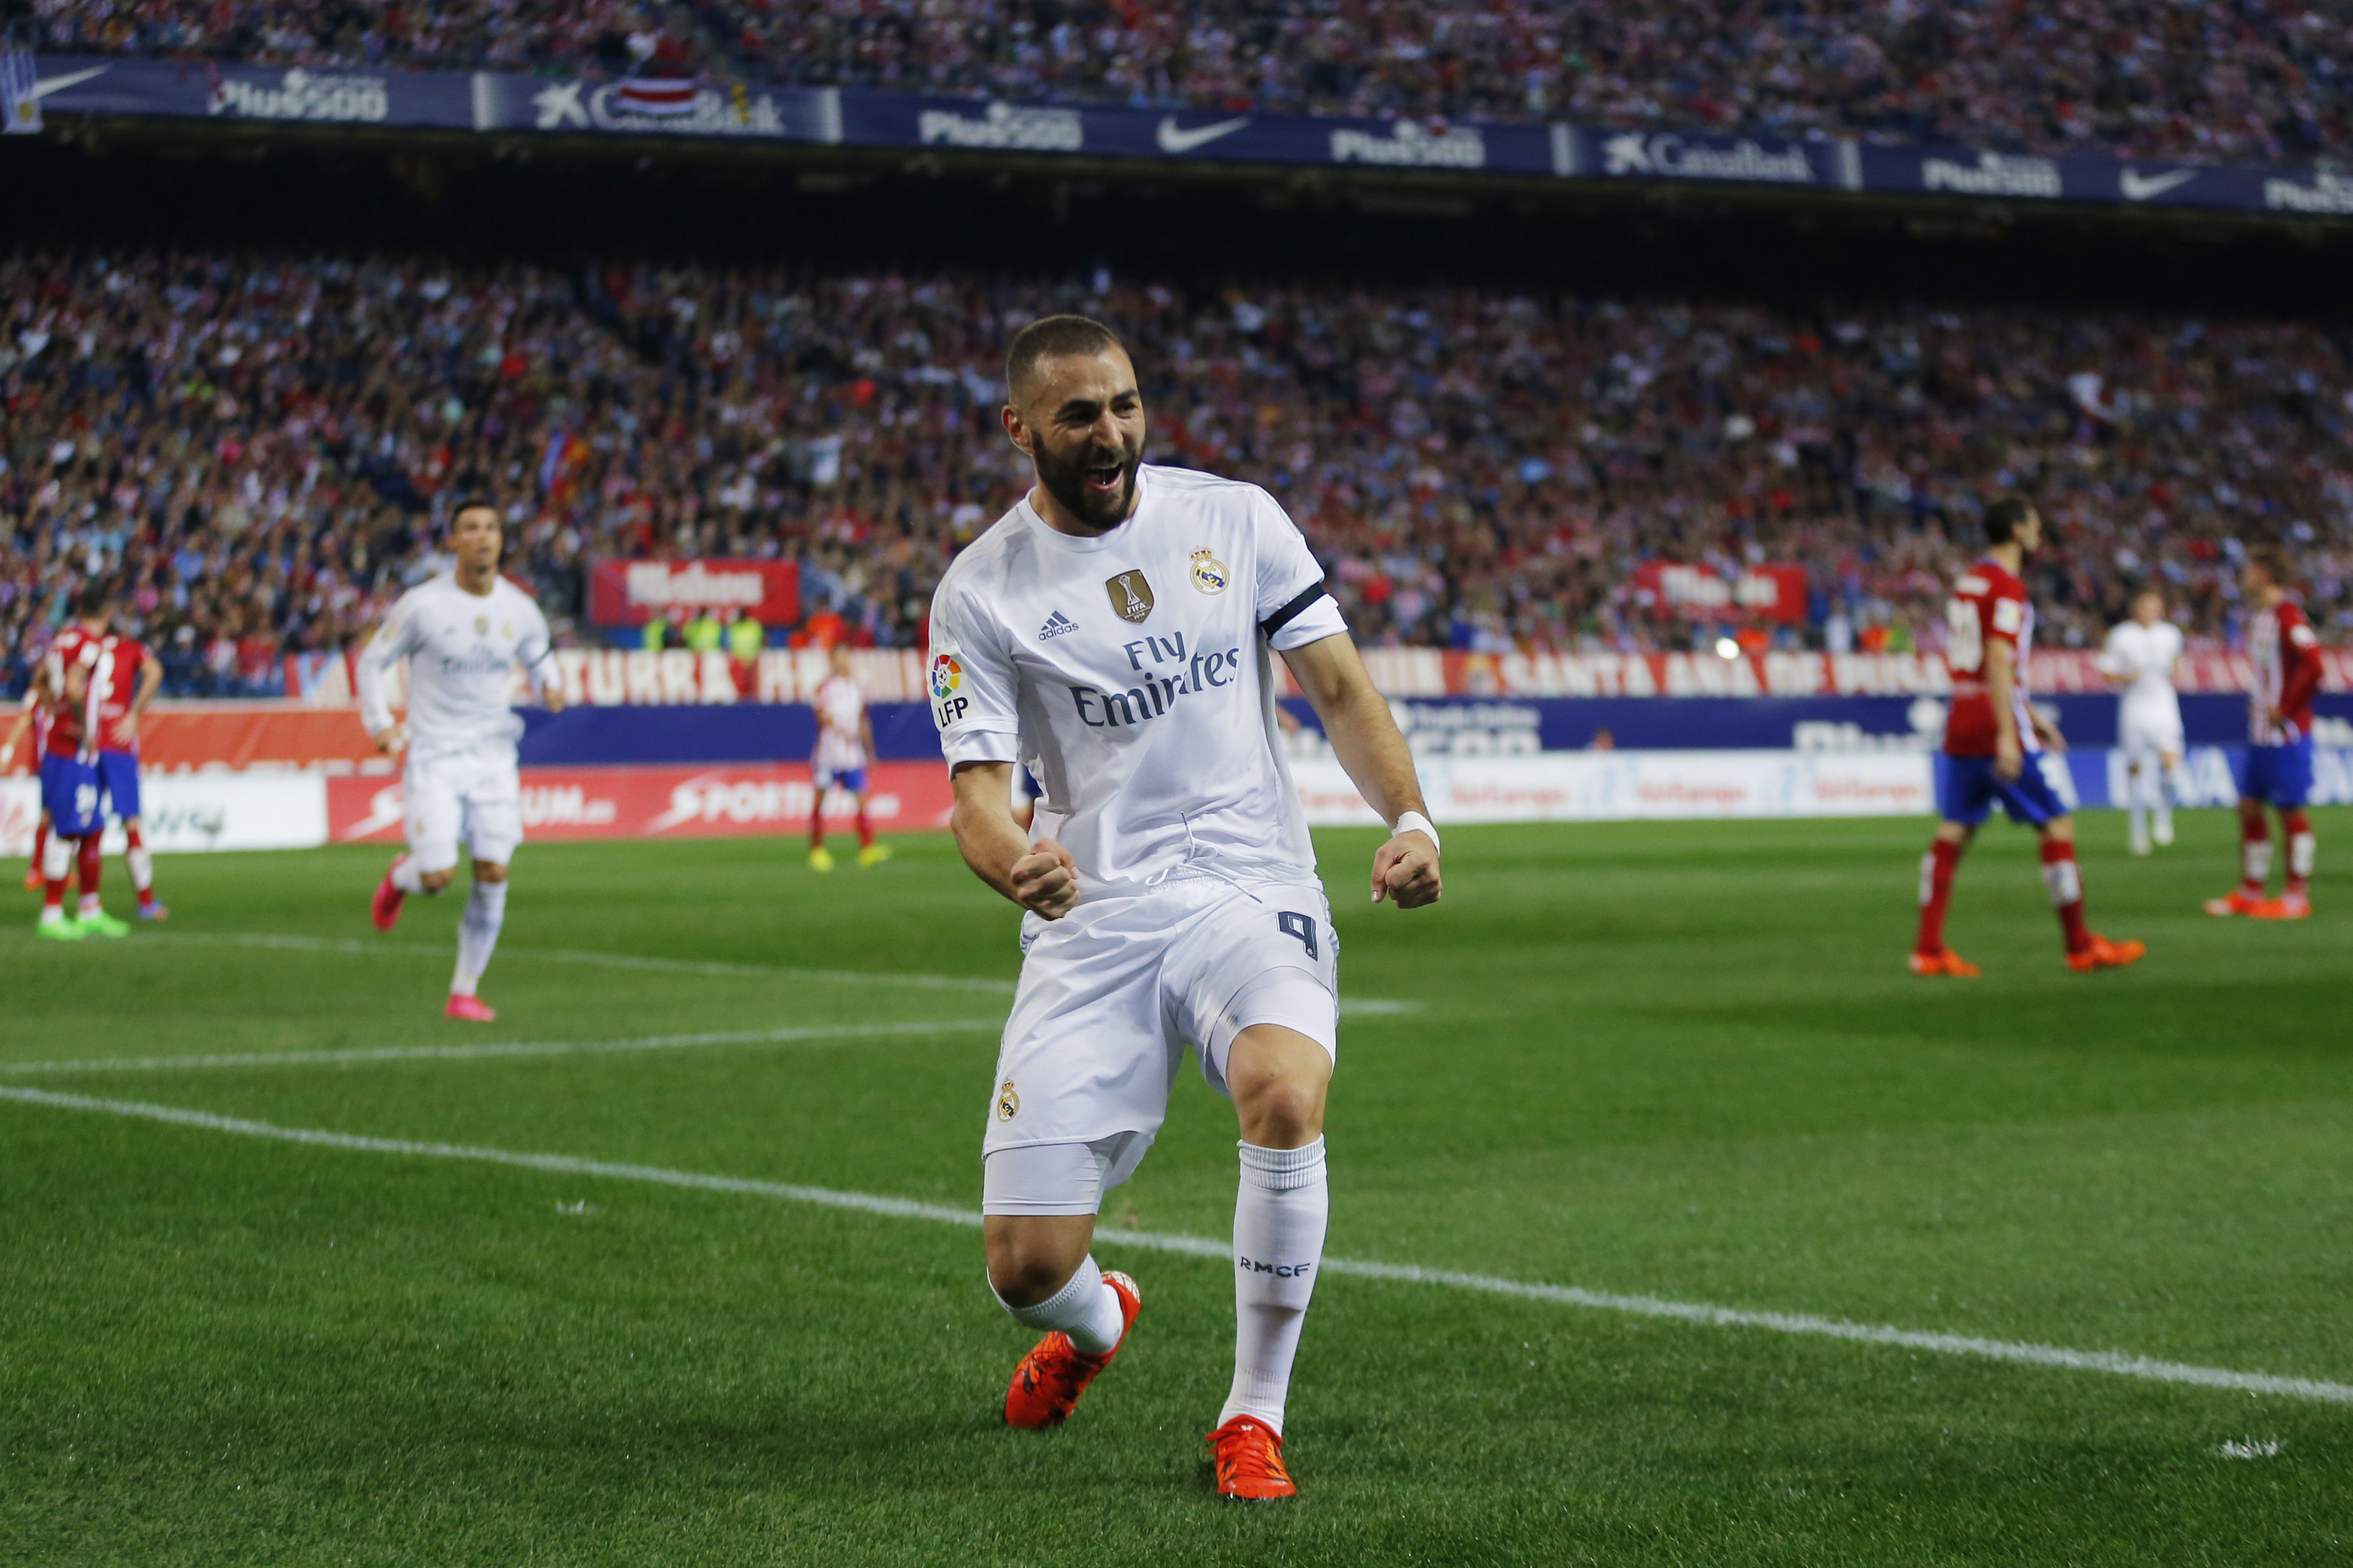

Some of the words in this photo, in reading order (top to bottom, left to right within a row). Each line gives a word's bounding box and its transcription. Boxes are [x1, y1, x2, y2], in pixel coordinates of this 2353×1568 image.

[1126, 602, 1146, 614] FIFA
[1038, 623, 1079, 641] adidas
[1123, 631, 1186, 671] Fly
[938, 697, 968, 728] LFP
[1275, 911, 1318, 962] 9
[1240, 1256, 1310, 1277] RMCF
